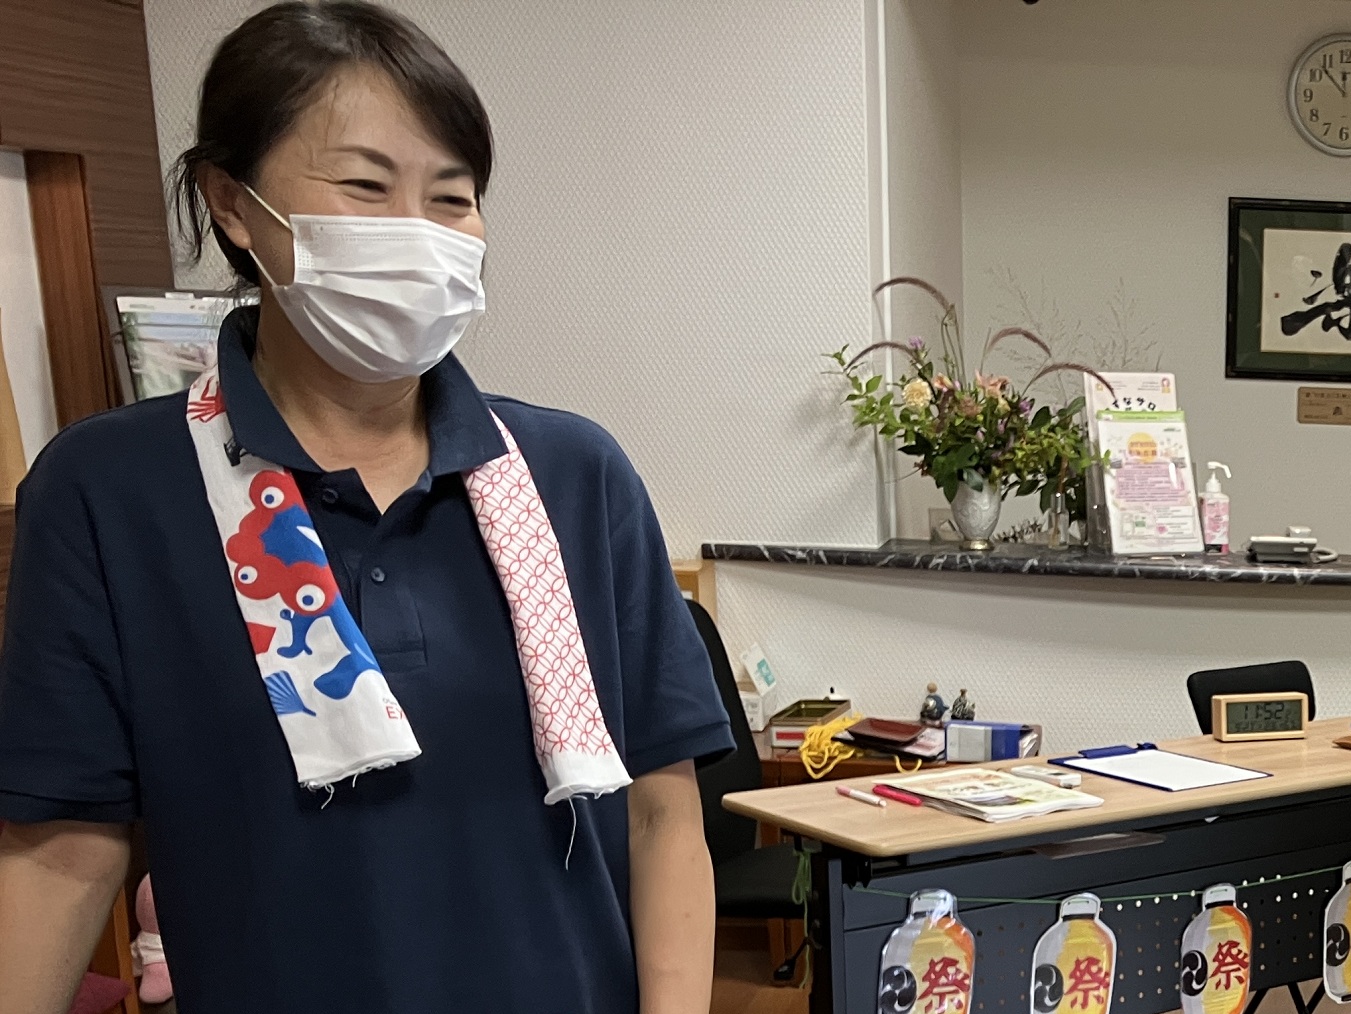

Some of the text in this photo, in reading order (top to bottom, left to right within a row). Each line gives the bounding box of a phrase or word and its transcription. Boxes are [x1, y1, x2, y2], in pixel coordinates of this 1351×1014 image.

[1310, 69, 1323, 83] 10
[1303, 88, 1313, 103] 9
[1310, 108, 1319, 122] 8
[1322, 122, 1332, 136] 7
[1339, 126, 1350, 141] 6
[1210, 940, 1250, 991] 祭
[1063, 956, 1111, 1010] 祭
